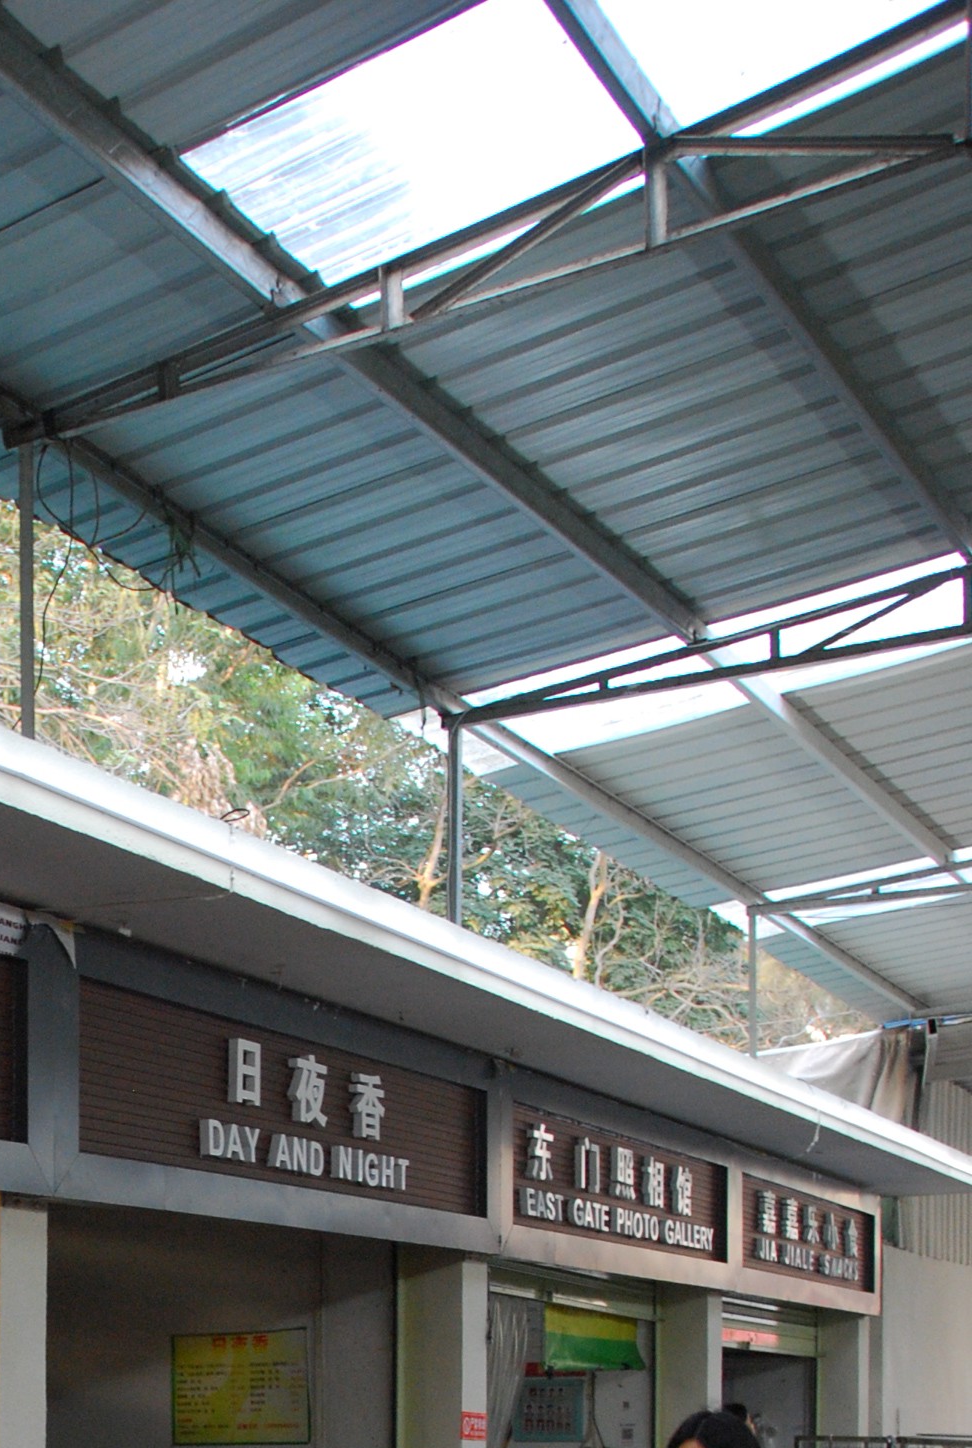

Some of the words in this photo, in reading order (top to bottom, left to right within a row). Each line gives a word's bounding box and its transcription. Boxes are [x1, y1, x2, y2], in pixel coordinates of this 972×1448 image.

[229, 1038, 385, 1140] 日夜香
[199, 1118, 260, 1163] DAY
[267, 1134, 324, 1176] AND
[330, 1145, 409, 1190] NIGHT
[526, 1123, 693, 1217] 东门照相馆
[519, 1187, 564, 1222] EAST
[568, 1198, 609, 1232] GATE
[611, 1206, 660, 1241] PHOTO
[661, 1219, 714, 1251] GALLERY
[755, 1237, 777, 1262] JIA
[779, 1243, 815, 1271] JIALE
[818, 1254, 859, 1281] SNACKS
